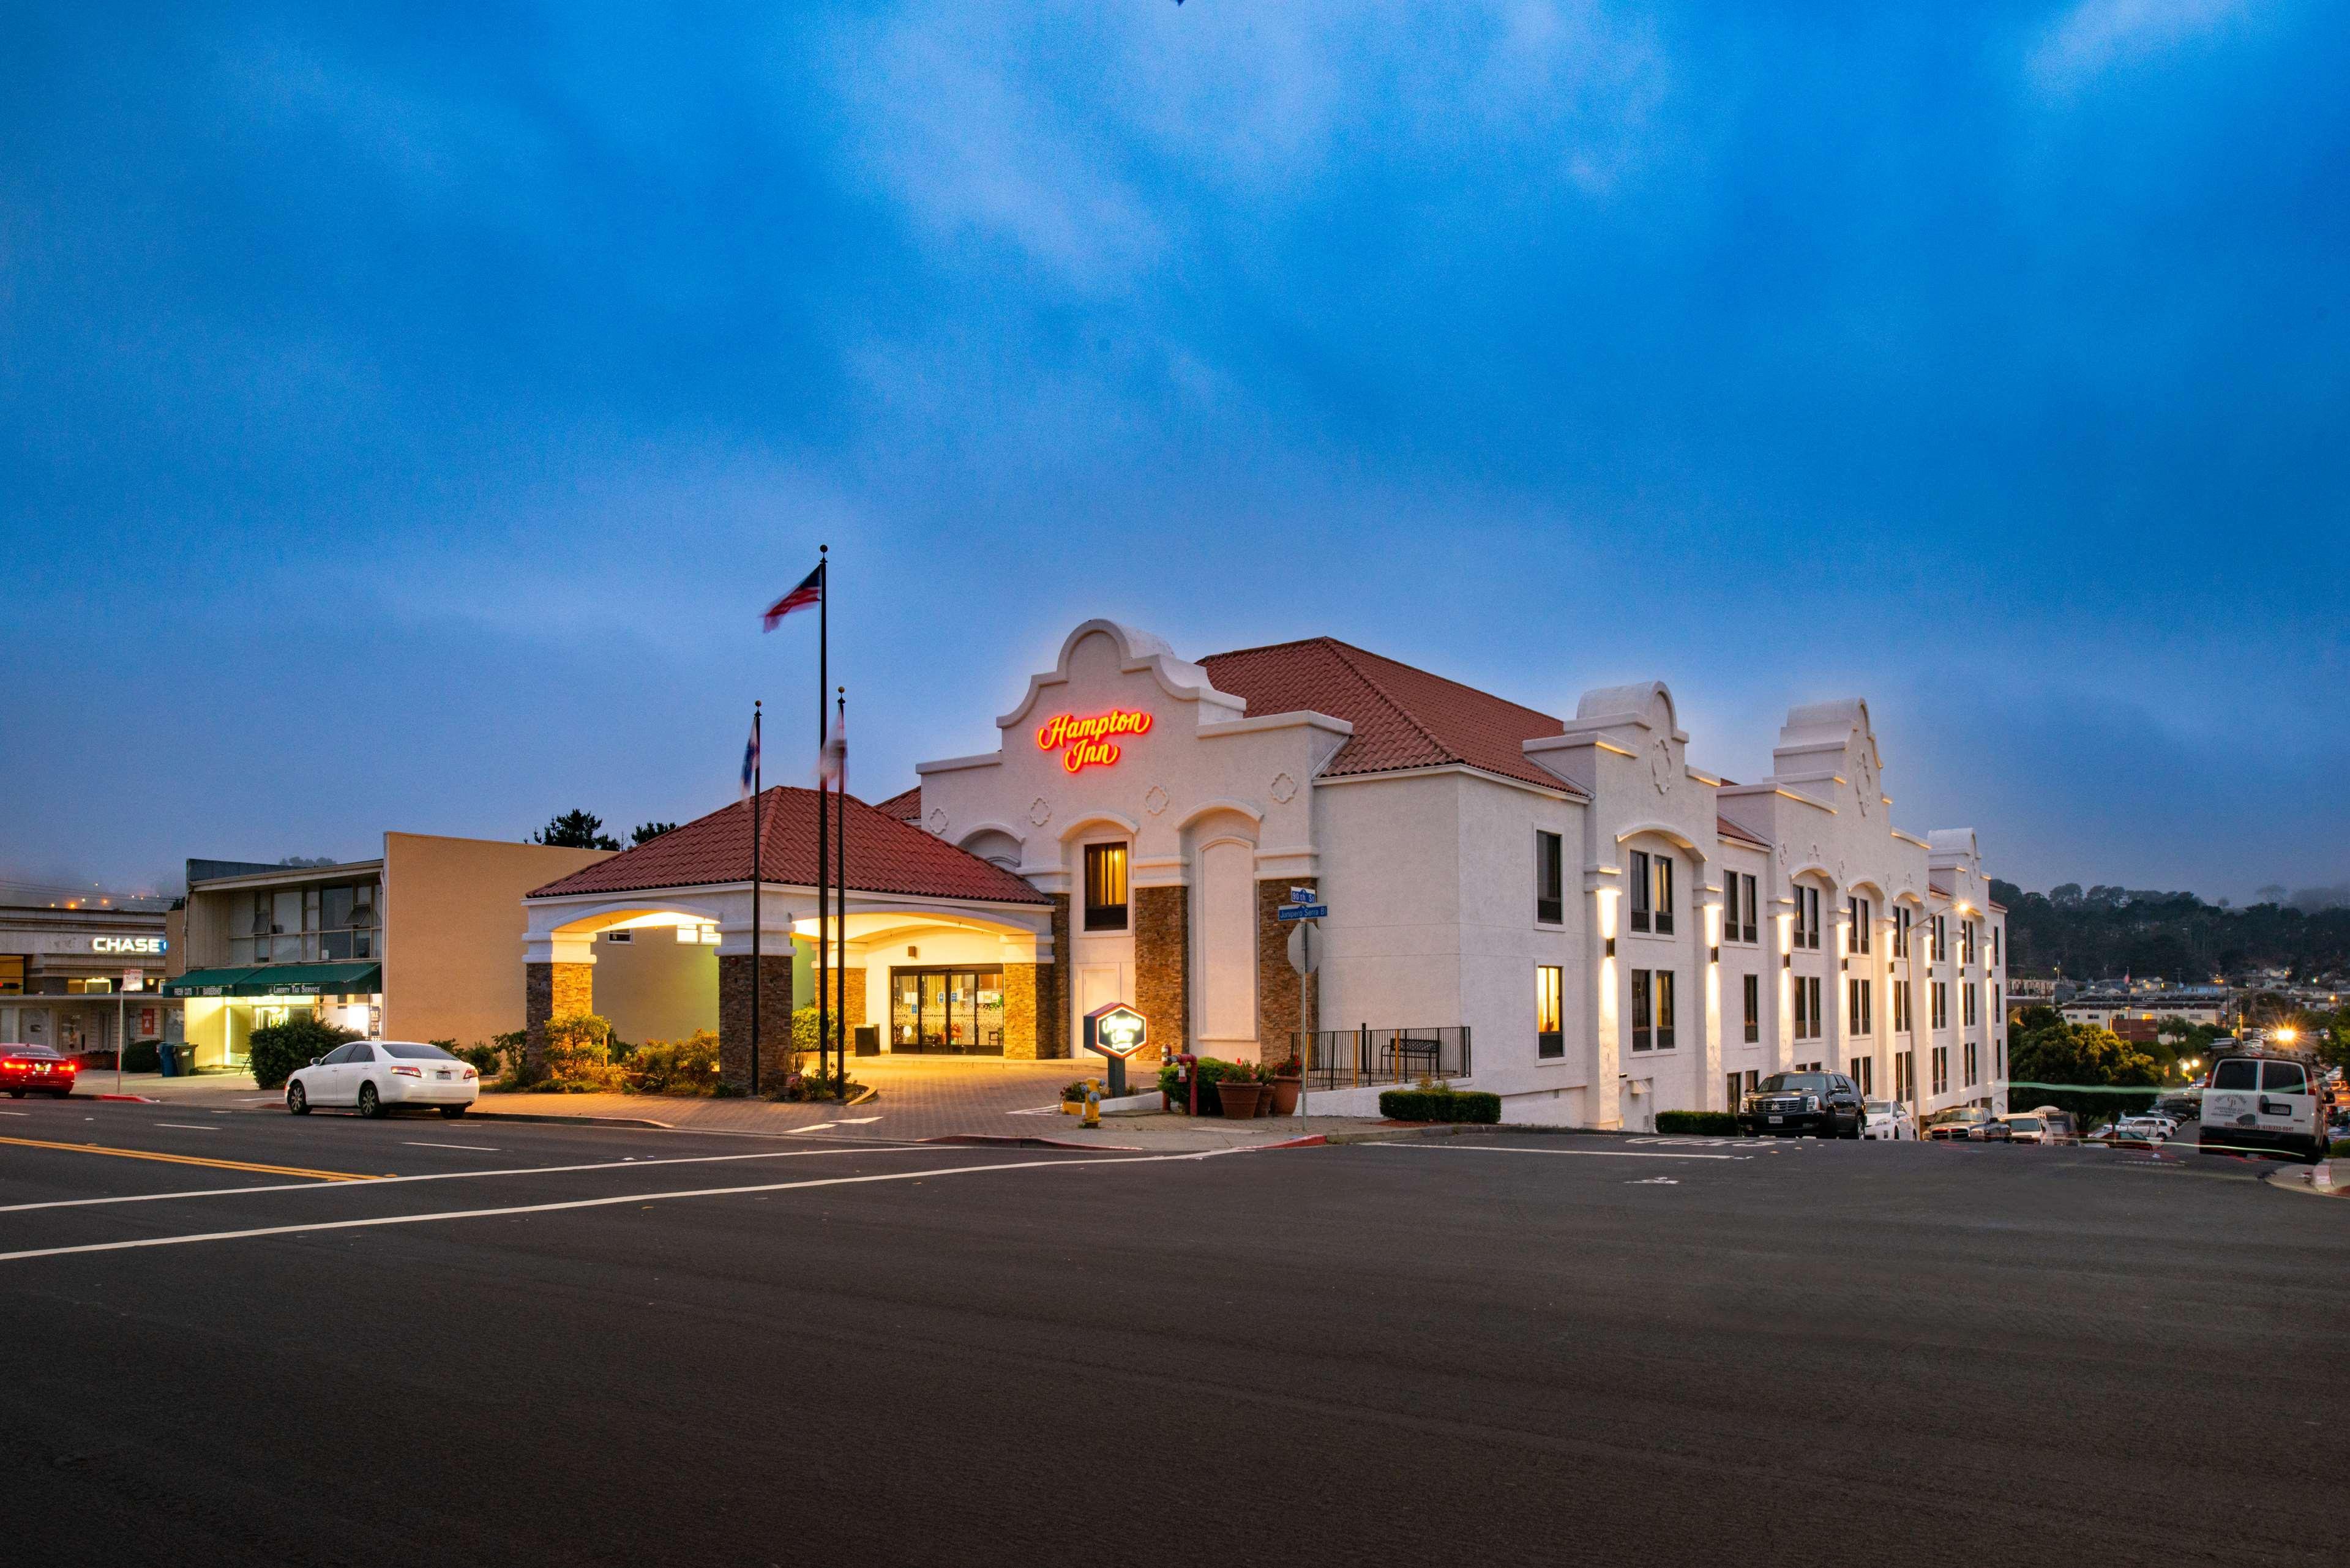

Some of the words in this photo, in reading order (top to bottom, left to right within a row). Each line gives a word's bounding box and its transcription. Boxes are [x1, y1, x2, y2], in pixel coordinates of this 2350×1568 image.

[1037, 709, 1153, 750] Hampton
[1064, 738, 1121, 773] Inn
[1292, 892, 1306, 901] 90th
[93, 937, 160, 952] CHASE
